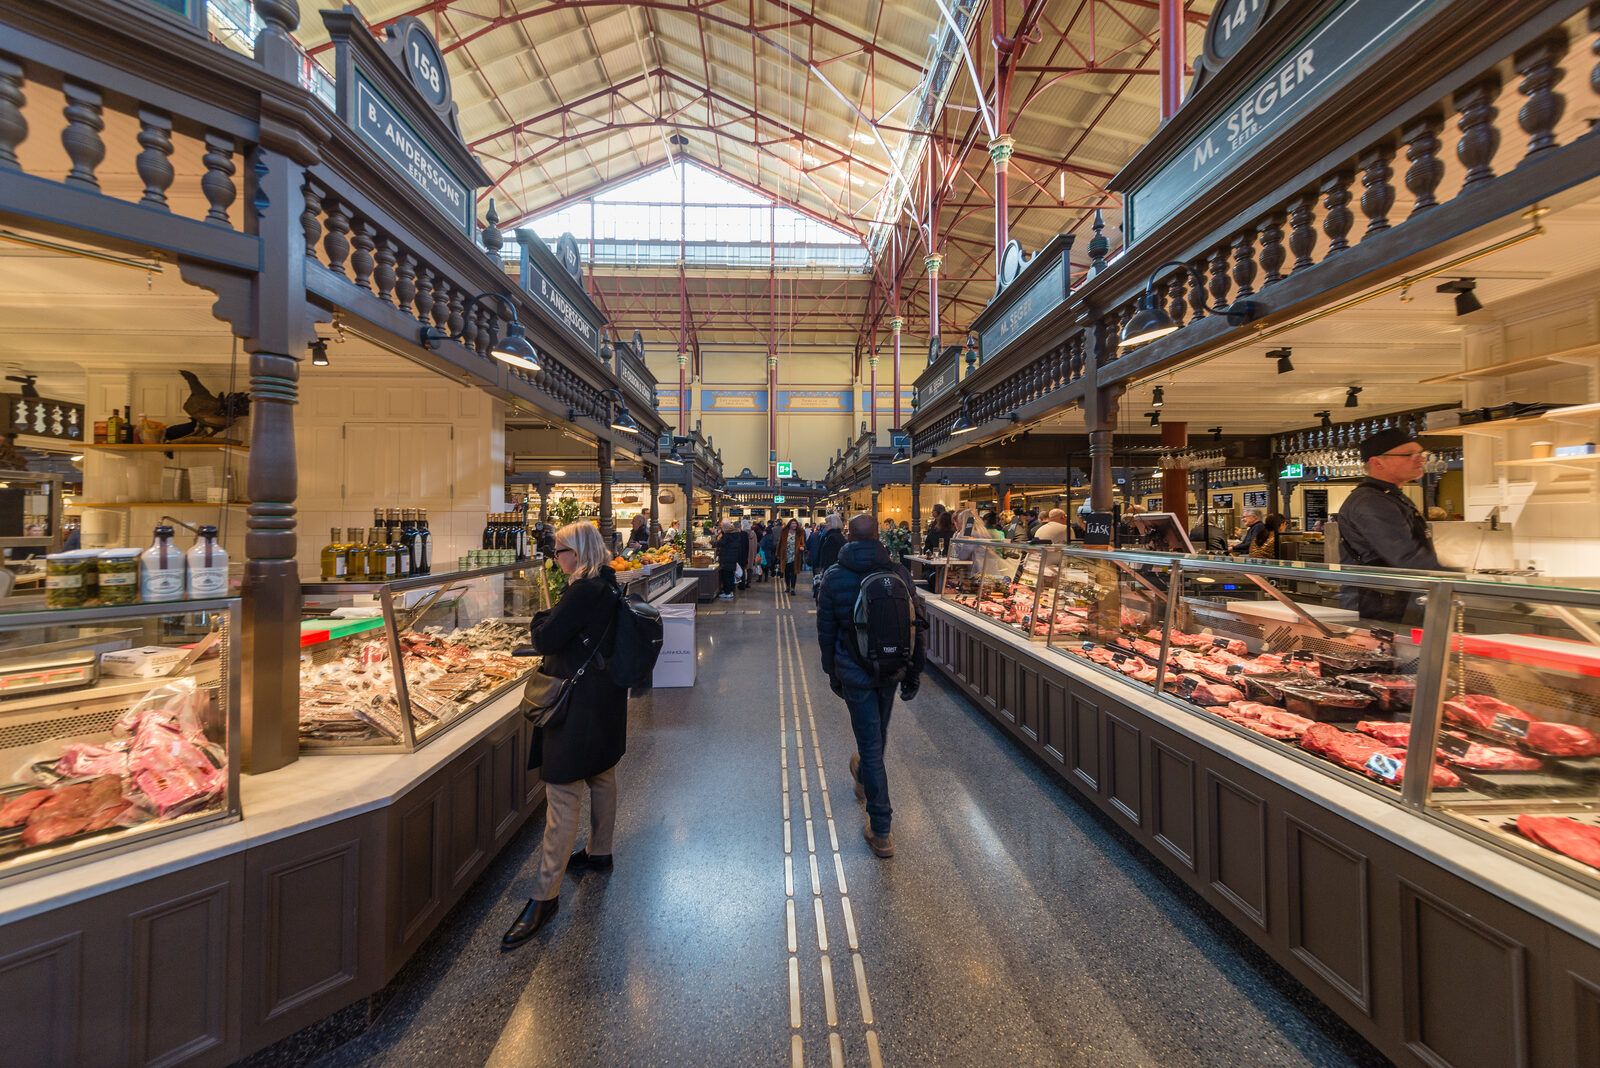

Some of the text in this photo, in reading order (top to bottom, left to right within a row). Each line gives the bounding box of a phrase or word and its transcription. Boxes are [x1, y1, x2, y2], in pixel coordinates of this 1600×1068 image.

[412, 42, 440, 93] 158
[1193, 49, 1316, 172] M. SEGER
[1231, 124, 1263, 151] EFTR.
[368, 103, 460, 206] B. ANDERSSONS
[408, 163, 431, 191] EFTR.
[566, 246, 577, 267] 157
[541, 280, 590, 339] B. ANDERSSONS
[1010, 299, 1032, 324] SEGER
[1086, 522, 1110, 536] FLÄSK
